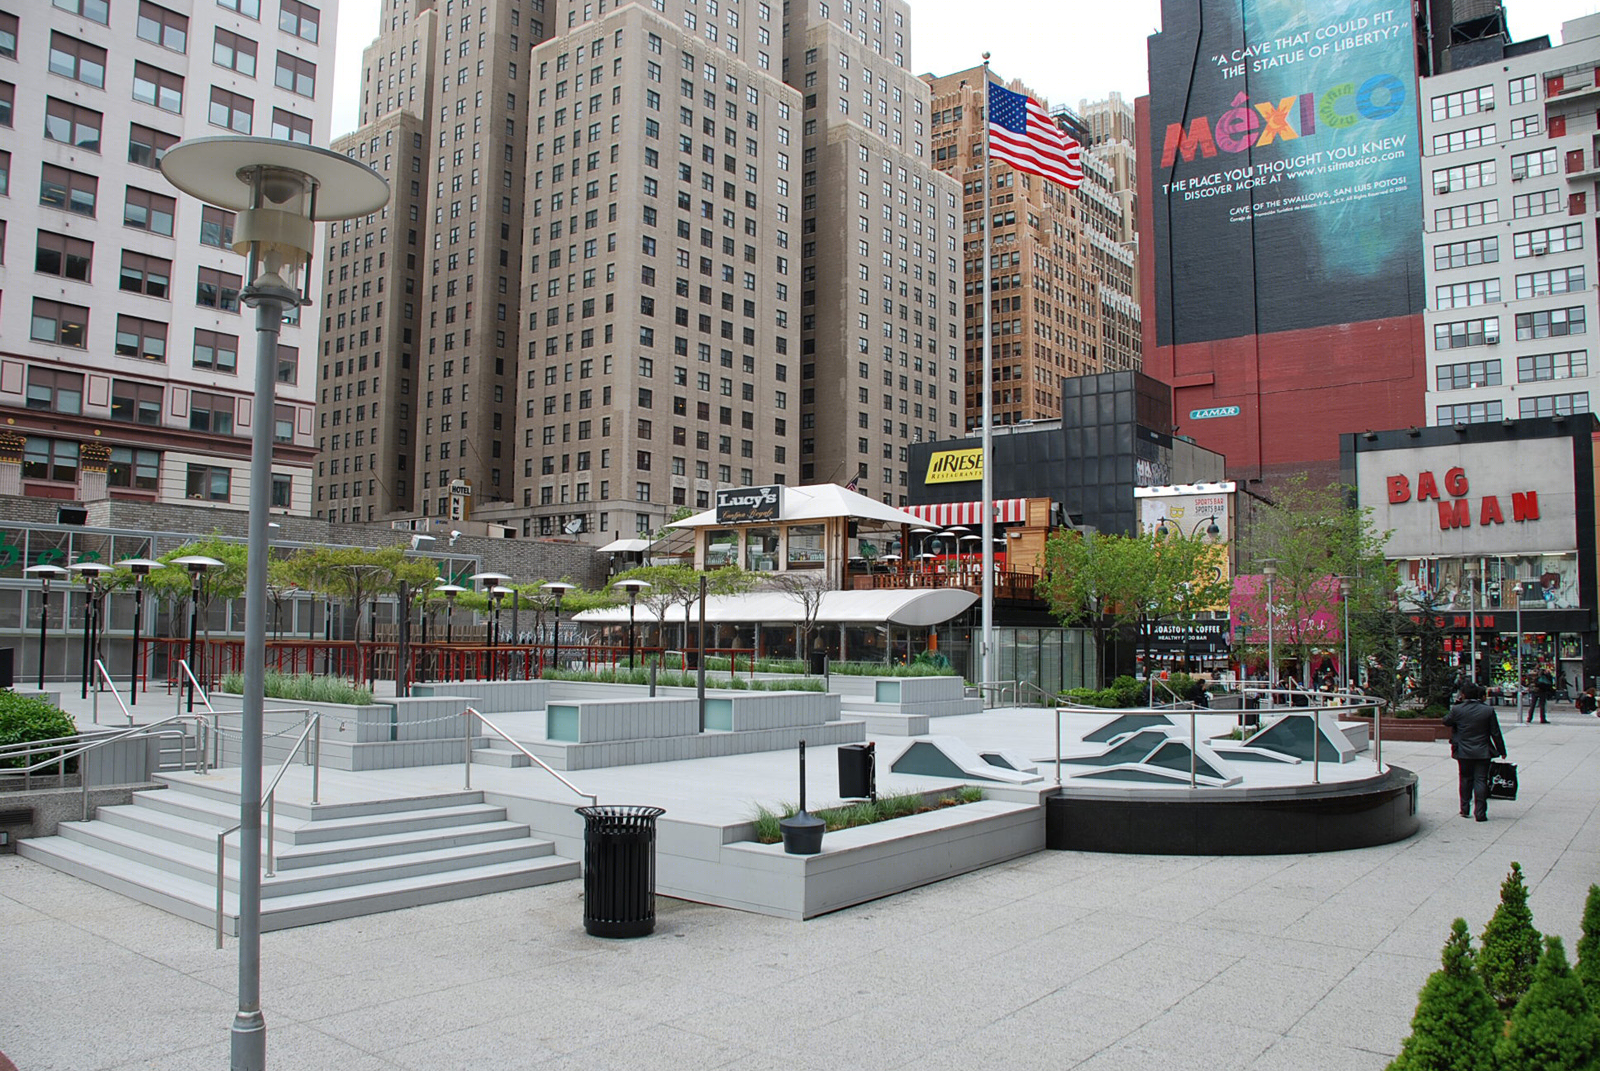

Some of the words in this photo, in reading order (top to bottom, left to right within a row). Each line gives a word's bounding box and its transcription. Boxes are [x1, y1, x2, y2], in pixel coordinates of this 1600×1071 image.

[1231, 41, 1271, 63] CAVE
[1275, 31, 1310, 51] THAT
[1315, 17, 1368, 40] COULD
[1373, 10, 1394, 26] FIT
[1222, 64, 1246, 80] THE
[1253, 49, 1304, 73] STATUE
[1308, 43, 1329, 58] OF
[1162, 180, 1187, 195] THE
[1189, 173, 1221, 189] PLACE
[1224, 166, 1253, 181] YOU
[1256, 151, 1322, 176] THOUGHT
[1326, 145, 1357, 160] YOU
[1361, 134, 1407, 154] KNEW
[1184, 184, 1232, 201] DISCOVER
[1236, 176, 1267, 191] MORE
[1269, 173, 1282, 184] AT
[1286, 150, 1405, 179] www.visitmexico.com
[1229, 205, 1250, 215] CAVE
[1253, 202, 1264, 211] OF
[1266, 200, 1281, 208] THE
[1283, 190, 1331, 206] SWALLOWS,
[1333, 186, 1352, 196] SAN
[1353, 182, 1372, 192] LUIS
[1373, 176, 1407, 188] POTOSI
[1196, 407, 1236, 418] LAMAR
[943, 454, 984, 472] RIESE
[931, 471, 983, 480] RESTAURANTS
[1386, 466, 1469, 504] BAG
[452, 485, 471, 495] HOTEL
[717, 488, 777, 509] Lucy's
[1195, 498, 1213, 506] SPORTS
[1214, 497, 1224, 505] BAR
[1195, 505, 1214, 513] SPORTS
[1438, 491, 1540, 530] MAN
[1195, 625, 1220, 634] COFFEE
[1454, 615, 1495, 628] MAN
